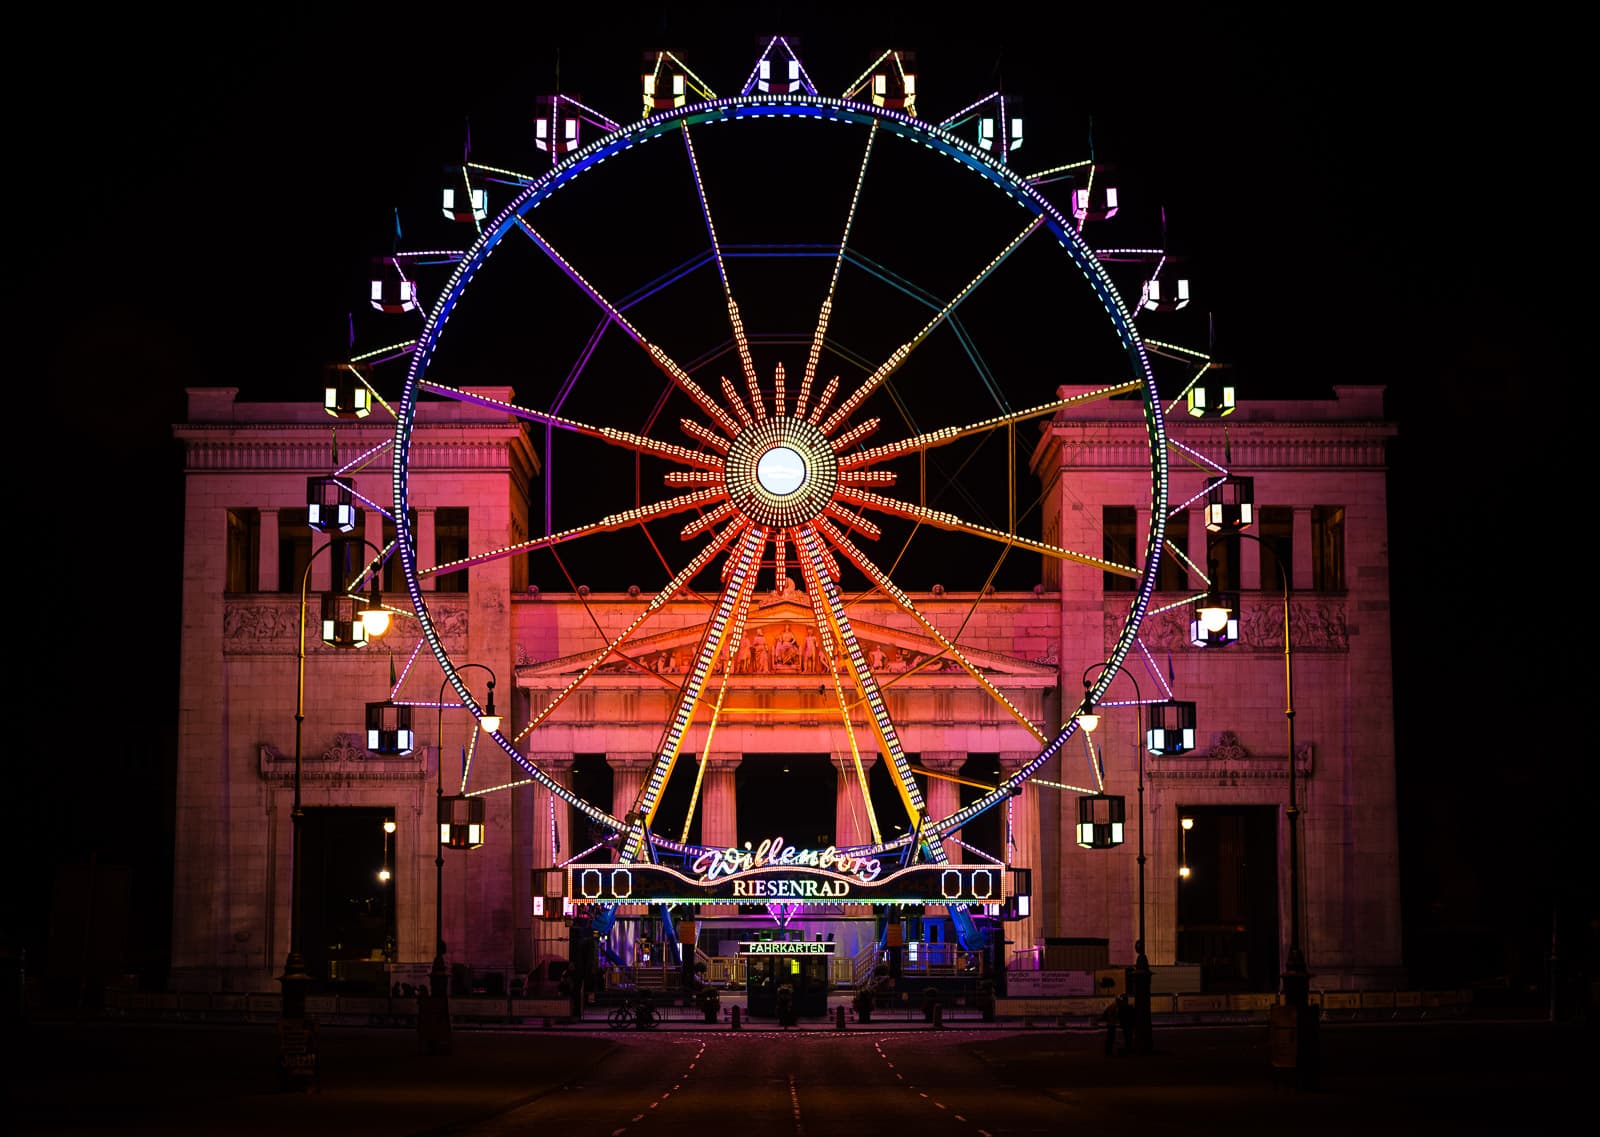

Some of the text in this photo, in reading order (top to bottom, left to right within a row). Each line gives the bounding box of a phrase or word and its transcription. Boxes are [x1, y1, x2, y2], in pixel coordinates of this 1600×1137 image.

[692, 836, 882, 882] Willenborg
[733, 880, 851, 897] RIESENRAD
[749, 944, 827, 954] FAHRKARTEN
